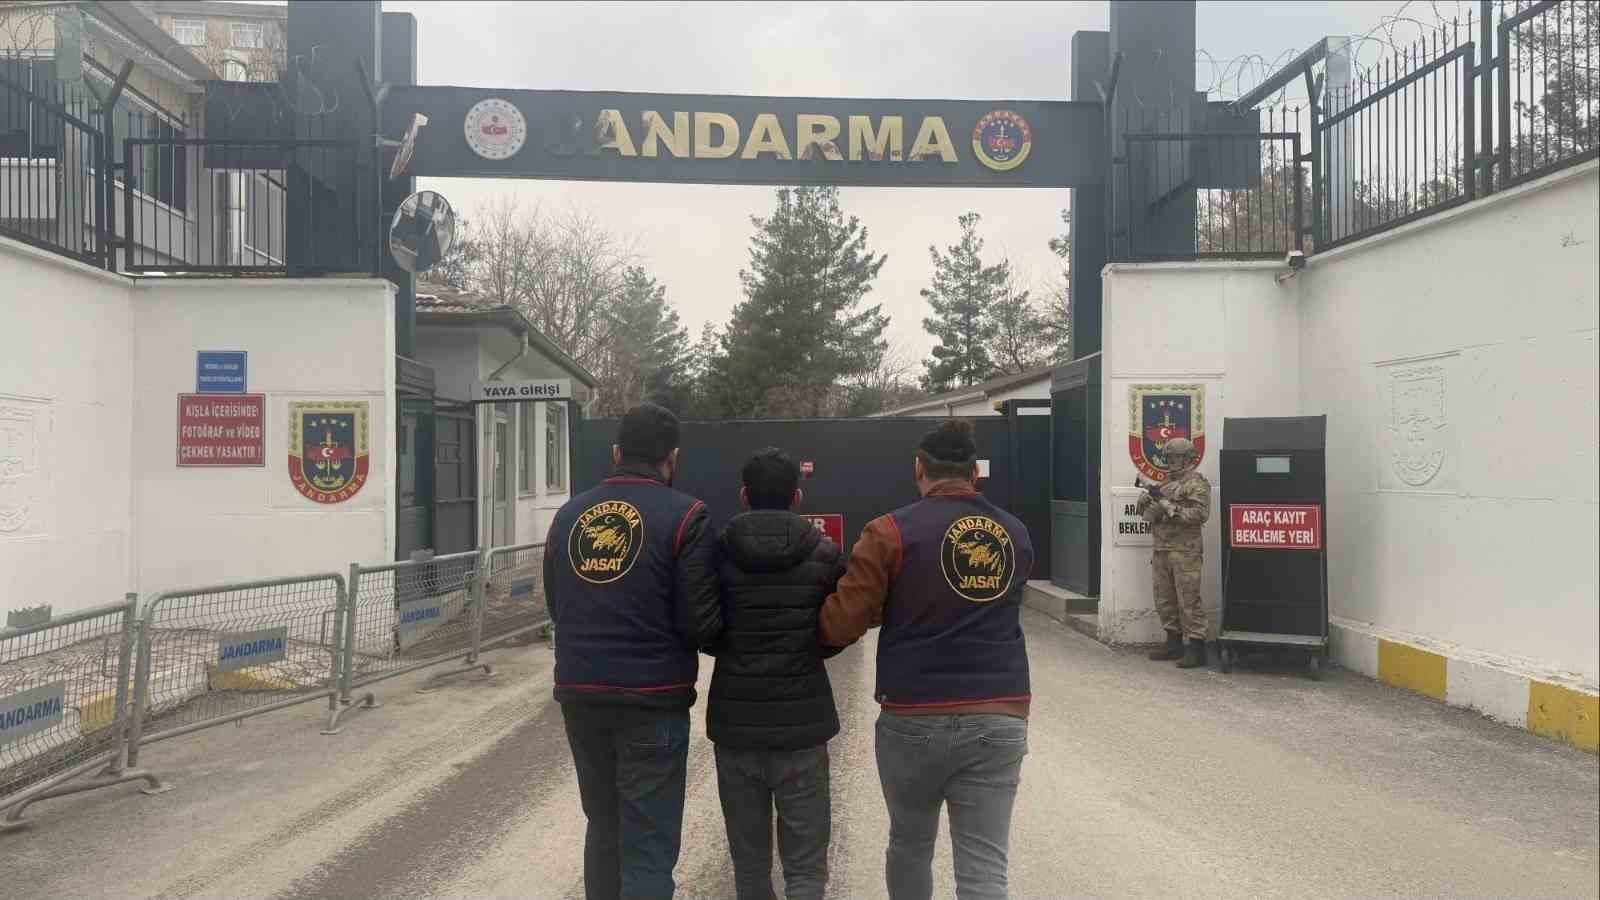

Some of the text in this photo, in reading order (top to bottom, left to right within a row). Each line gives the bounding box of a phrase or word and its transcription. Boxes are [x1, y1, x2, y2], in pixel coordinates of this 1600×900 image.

[545, 108, 959, 163] ANDARMA
[483, 383, 560, 397] YAYA GİRİŞİ
[182, 423, 261, 439] FOTOĞRAF ve VİDEO
[181, 445, 213, 461] ÇEKMEK
[215, 445, 256, 458] YASAKTIR
[580, 503, 640, 528] JANDARMA
[1242, 510, 1307, 527] ARAÇ KAYIT
[948, 518, 1009, 546] JANDARMA
[1235, 527, 1314, 544] BEKLEME YERİ
[581, 558, 623, 571] JASAT
[959, 575, 1001, 589] JASAT
[221, 638, 283, 658] JANDARMA
